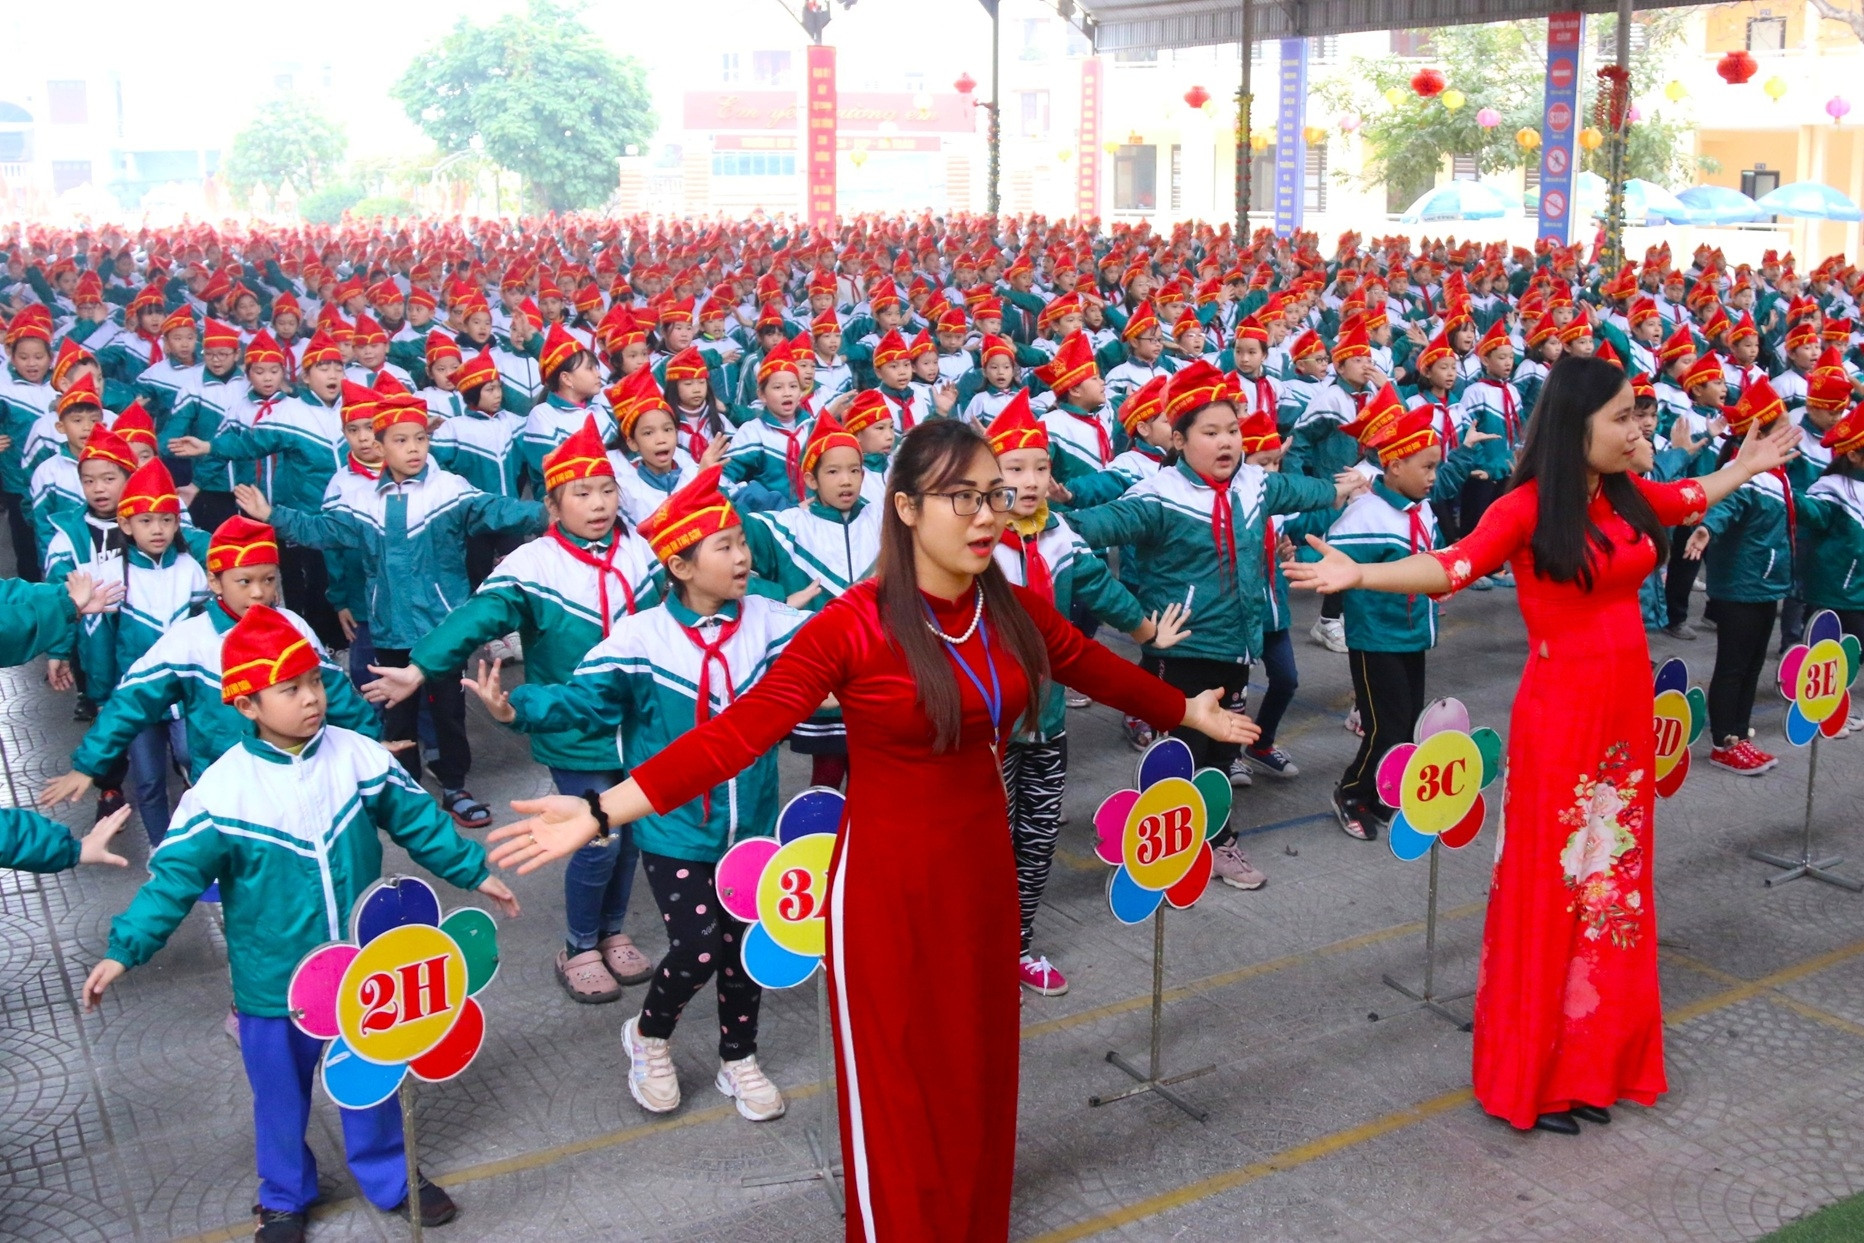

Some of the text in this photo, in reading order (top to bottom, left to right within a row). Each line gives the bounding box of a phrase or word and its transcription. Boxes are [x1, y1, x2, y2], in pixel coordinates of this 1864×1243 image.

[717, 96, 758, 120] Em
[766, 102, 797, 129] yê
[1548, 111, 1569, 124] STOP
[1805, 659, 1838, 700] 3E
[1416, 757, 1466, 802] 3C
[1136, 806, 1193, 864] 3B
[778, 868, 829, 922] 3
[360, 954, 452, 1036] 2H
